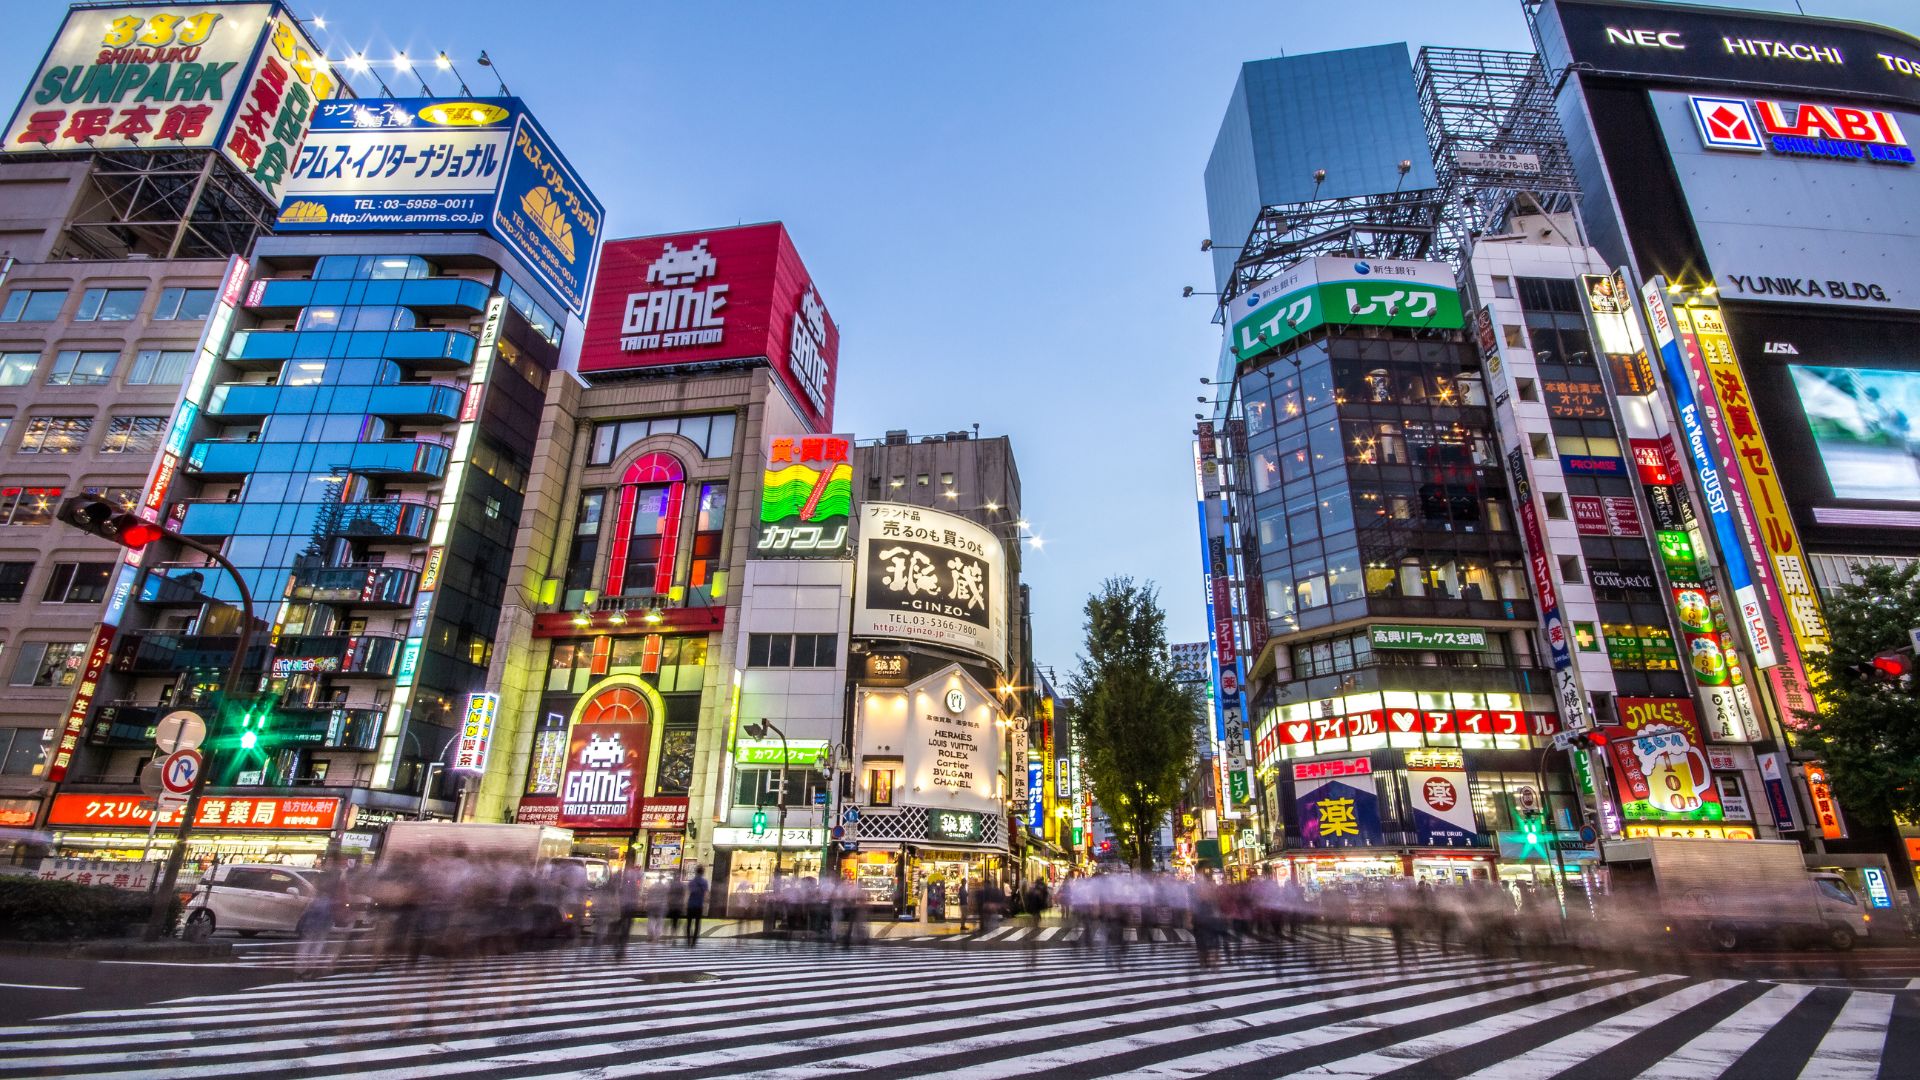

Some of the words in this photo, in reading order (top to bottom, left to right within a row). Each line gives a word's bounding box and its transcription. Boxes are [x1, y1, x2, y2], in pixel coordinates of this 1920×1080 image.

[1606, 27, 1685, 49] NEC
[96, 47, 201, 64] SHINJUKU
[1722, 37, 1844, 65] HITACHI
[35, 62, 238, 104] SUNPARK
[18, 105, 213, 144] 三平本館
[1754, 99, 1907, 147] LABI
[1771, 135, 1864, 159] SHINJUKU
[292, 143, 499, 179] アムス・インターナショナル
[516, 127, 595, 237] アムス・インターナショナル
[330, 211, 484, 224] http://www.amms.co.jp
[1373, 265, 1416, 276] 新生銀行
[1262, 274, 1298, 298] 新生銀行
[1728, 274, 1824, 299] YUNIKA
[1827, 281, 1892, 303] BLDG.
[621, 284, 729, 334] GAME
[1346, 288, 1437, 318] レイク
[1241, 295, 1312, 350] レイク
[1655, 303, 1669, 330] LABI
[1697, 322, 1722, 330] LABI
[620, 335, 660, 352] TAITO
[661, 328, 723, 348] STATION
[1764, 342, 1799, 355] LISA
[791, 311, 829, 403] GAME
[1552, 405, 1606, 417] マッサージ
[1560, 395, 1592, 405] オイル
[770, 437, 849, 463] 質・買取
[1635, 448, 1660, 458] FAST
[1637, 457, 1664, 467] NAIL
[1570, 459, 1617, 471] PROMISE
[1657, 473, 1667, 481] 6F
[1700, 462, 1729, 514] JUST
[870, 507, 921, 522] ブランド品
[1578, 511, 1601, 519] NAIL
[758, 525, 847, 550] カワノ
[882, 520, 941, 541] 売るのも
[942, 529, 986, 557] 買うのも
[1535, 556, 1556, 608] アイフル
[873, 622, 944, 639] http://ginzo.jp
[1219, 622, 1233, 662] アイフル
[1550, 625, 1564, 644] 薬
[1752, 617, 1770, 652] LABI
[1223, 677, 1236, 689] 薬
[1561, 671, 1584, 728] 大勝軒
[459, 697, 484, 767] まんが喫茶
[1226, 711, 1243, 754] 大勝軒
[1315, 713, 1378, 740] アイフル
[1428, 713, 1553, 735] アイフル
[1626, 702, 1698, 744] カルビちゃん
[928, 738, 949, 748] LOUIS
[950, 741, 978, 753] VUITTON
[938, 749, 968, 760] ROLEX
[932, 768, 973, 780] BVLGARI
[936, 758, 969, 770] Cartier
[1295, 756, 1371, 779] ミネドラッグ
[566, 769, 634, 802] GAME
[933, 777, 972, 789] CHANEL
[1233, 773, 1244, 799] レイク
[1426, 781, 1455, 807] 薬
[282, 801, 334, 814] 処方せん受付
[563, 804, 589, 815] TAITO
[589, 803, 628, 816] STATION
[1317, 797, 1360, 837] 薬
[41, 870, 148, 888] ポイ捨て禁止
[1867, 871, 1879, 886] P
